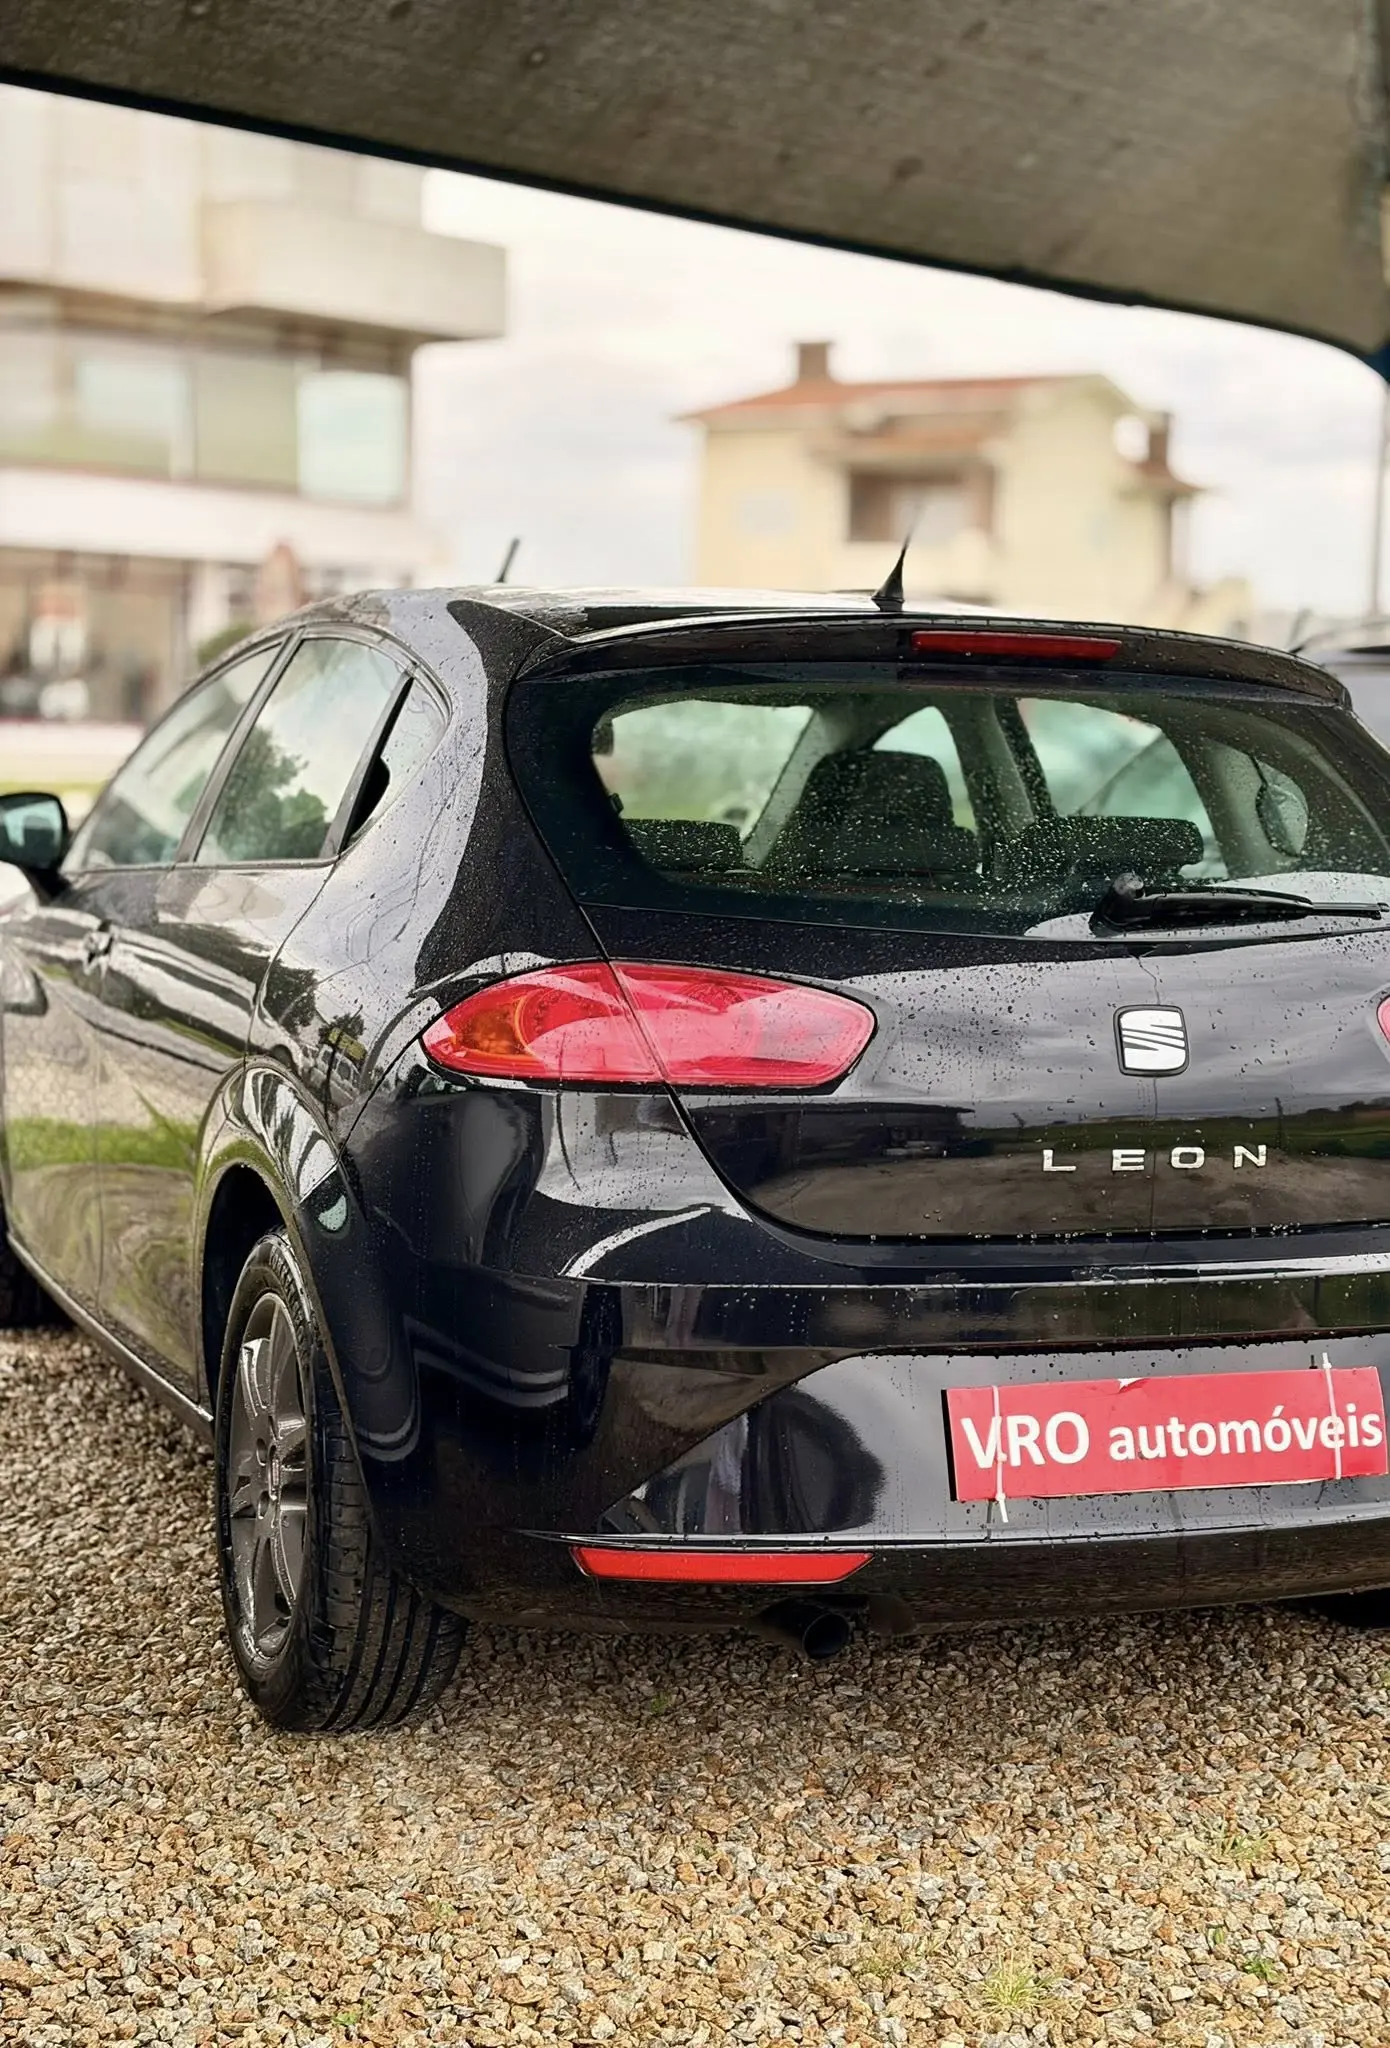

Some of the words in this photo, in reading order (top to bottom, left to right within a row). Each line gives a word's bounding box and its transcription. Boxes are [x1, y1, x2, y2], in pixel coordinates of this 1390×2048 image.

[1043, 1144, 1267, 1172] LEON
[960, 1411, 1091, 1470] VRO
[1108, 1402, 1384, 1462] automóveis
